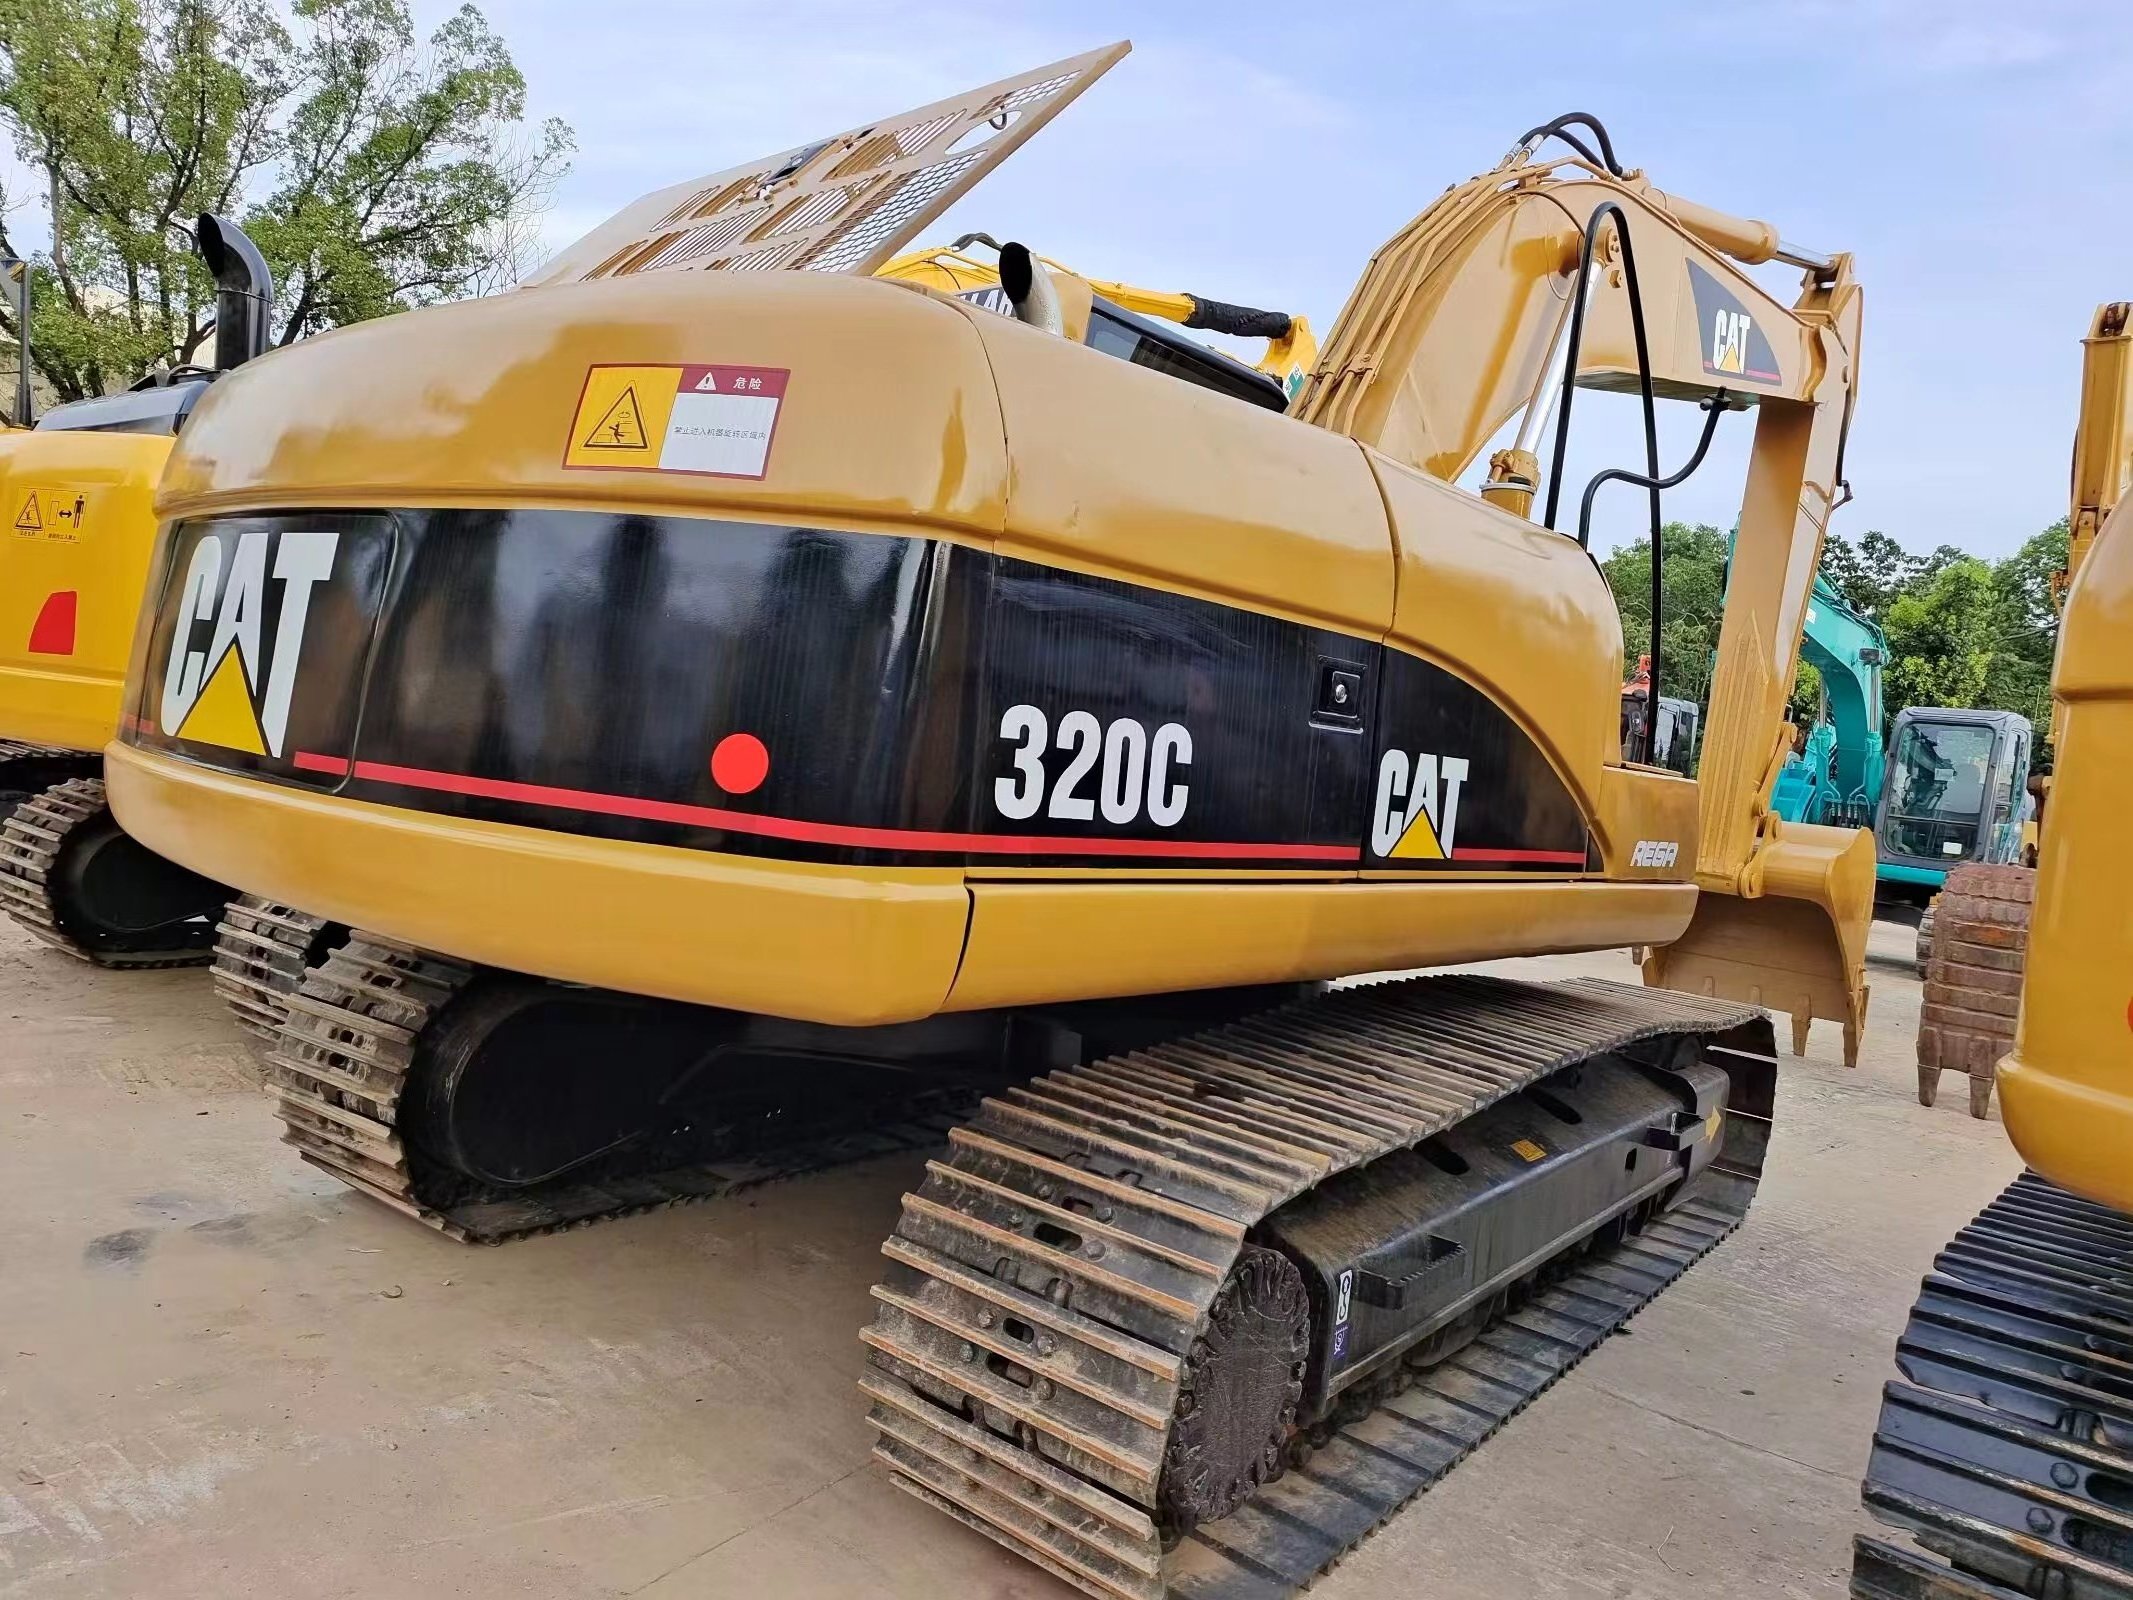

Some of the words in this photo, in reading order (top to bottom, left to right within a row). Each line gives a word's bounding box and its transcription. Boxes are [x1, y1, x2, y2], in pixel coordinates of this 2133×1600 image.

[732, 377, 763, 390] 危险
[1713, 309, 1751, 375] CAT
[161, 532, 340, 758] CAT
[994, 704, 1193, 827] 320C
[1371, 748, 1470, 859] CAT
